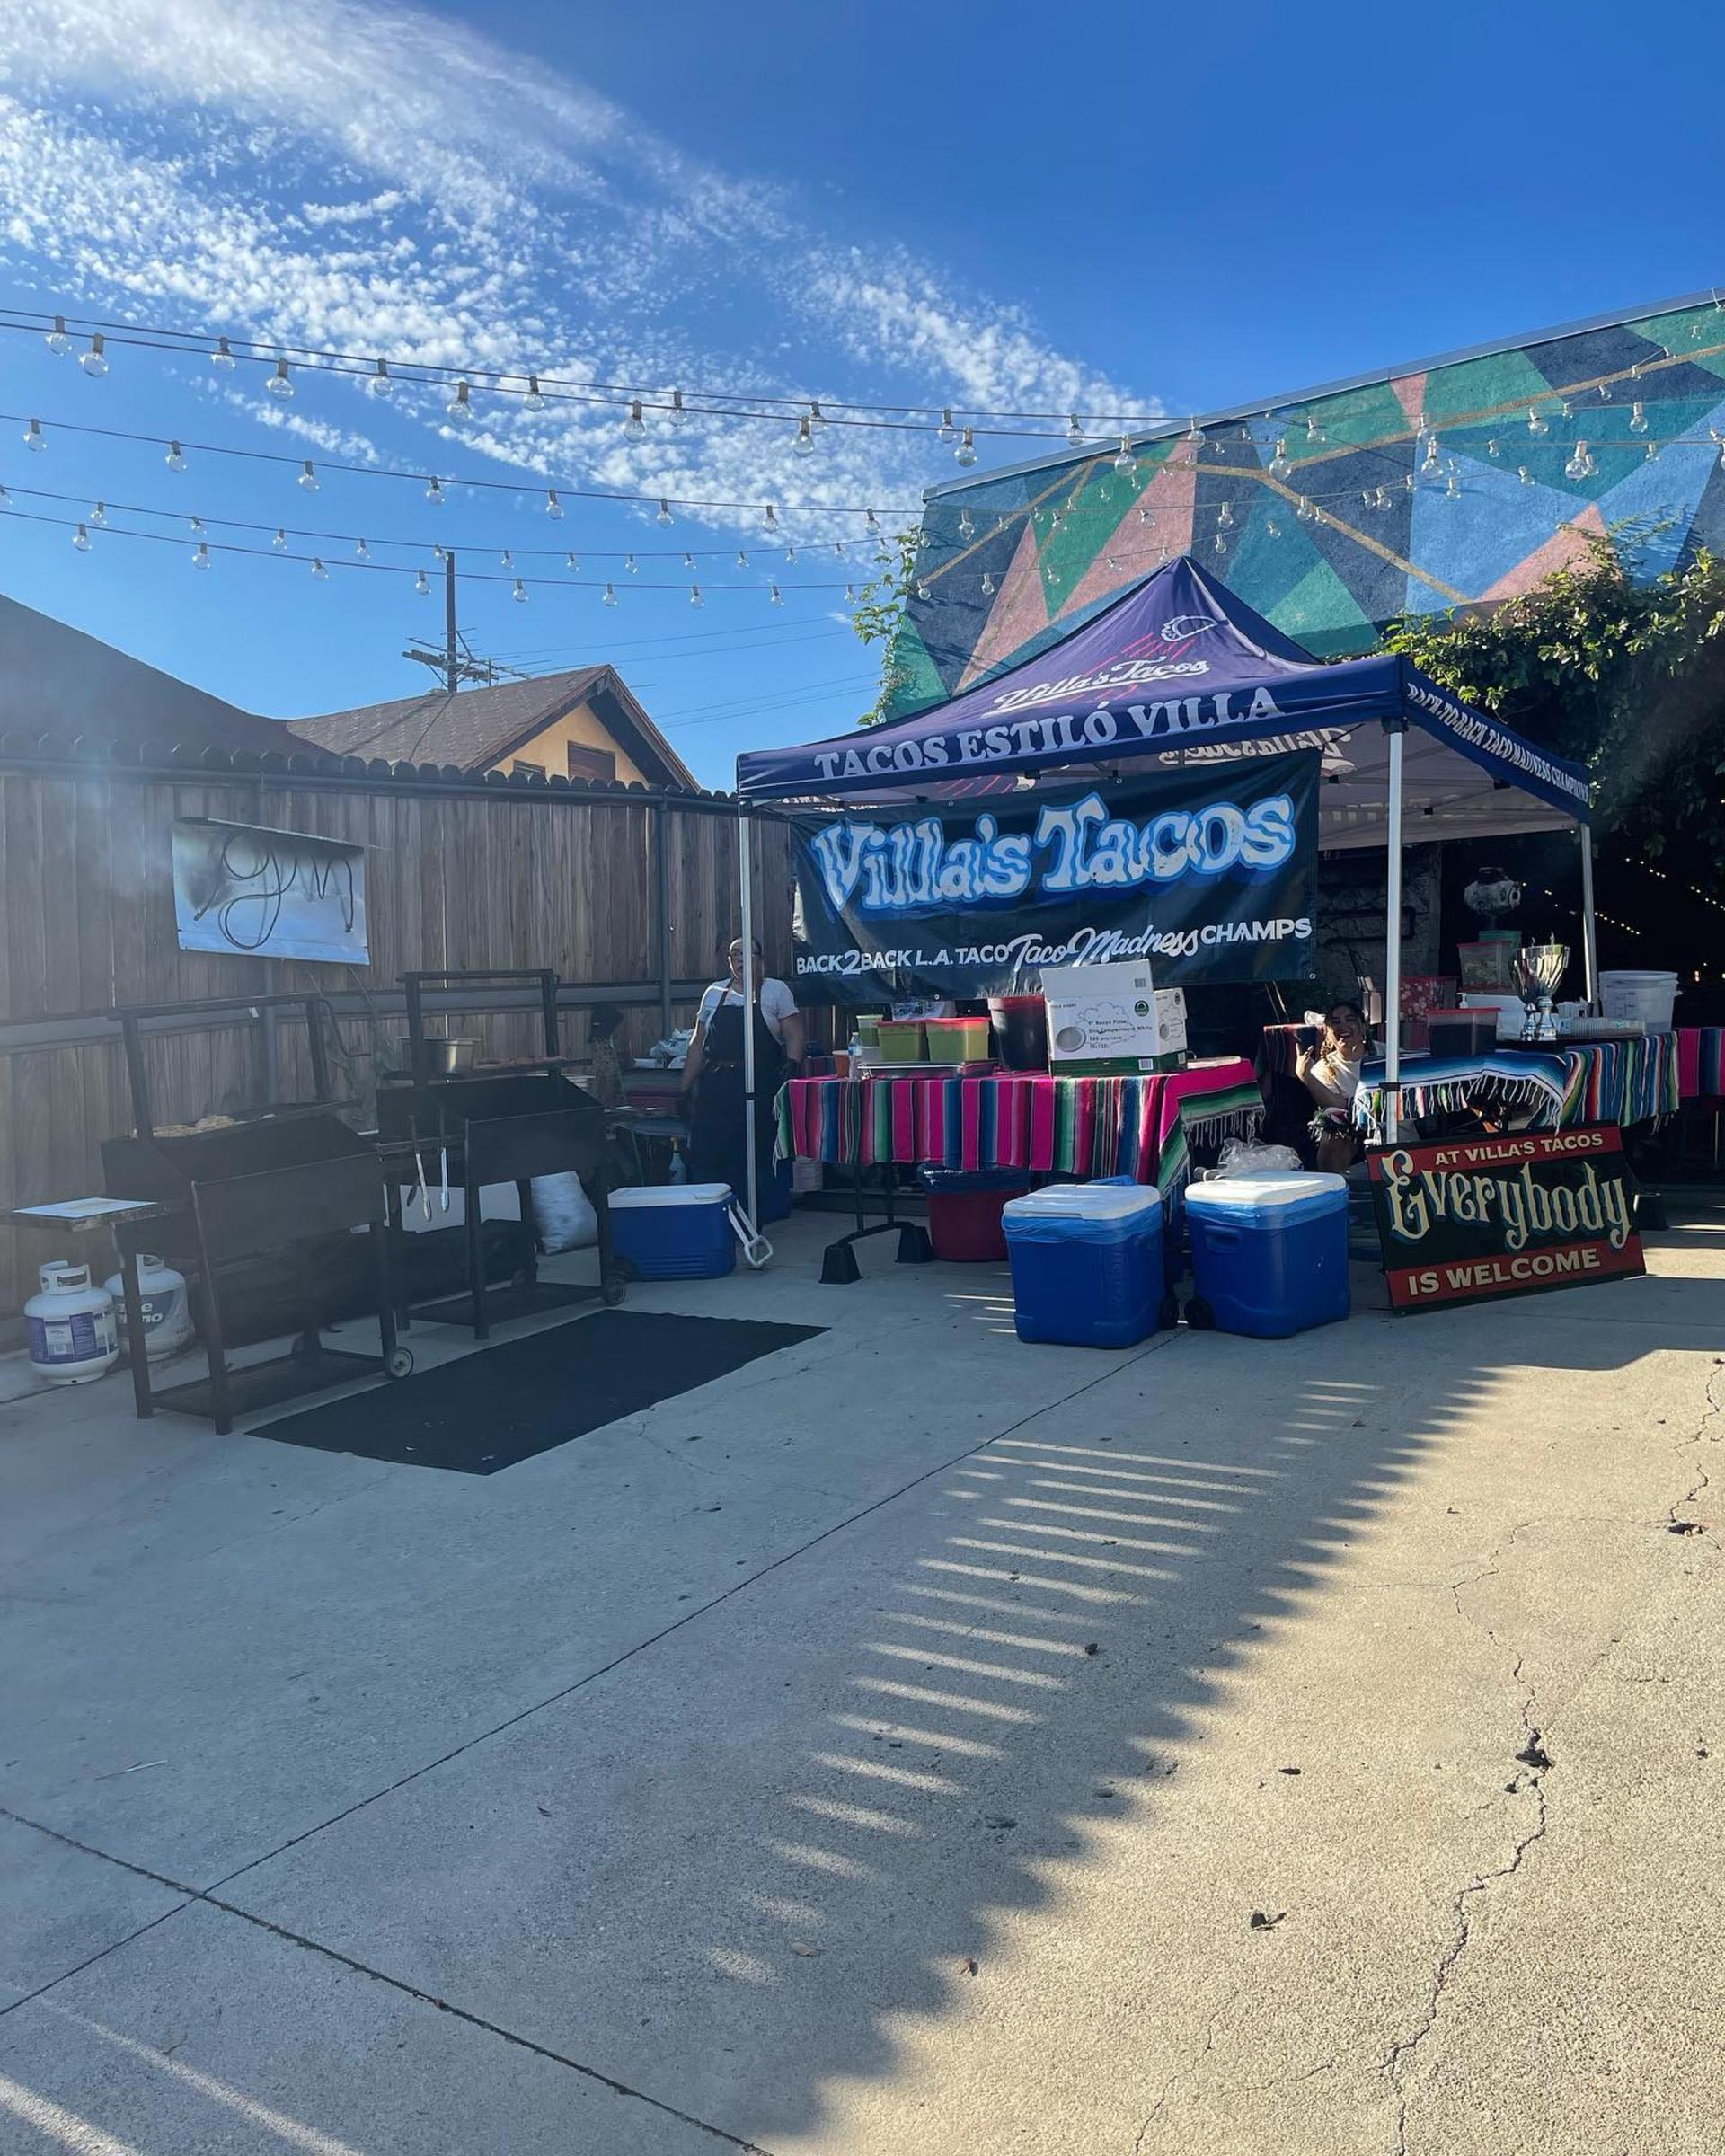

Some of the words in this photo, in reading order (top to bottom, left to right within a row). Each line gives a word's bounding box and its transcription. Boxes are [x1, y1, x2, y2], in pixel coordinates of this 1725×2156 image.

[994, 672, 1110, 708] Villa's
[1111, 656, 1211, 681] Tacos
[814, 735, 951, 780] TACOS
[957, 701, 1118, 764] ESTILÓ
[1128, 686, 1287, 737] VILLA
[1482, 729, 1513, 759] TACO
[1508, 744, 1551, 782] MADNESS
[812, 813, 1033, 910] Villa's
[1034, 792, 1296, 890] Tacos
[915, 948, 954, 967] L.A.
[955, 945, 1009, 965] TACO
[1006, 933, 1068, 973] Taco
[1067, 924, 1199, 968] Madness
[1200, 918, 1313, 944] CHAMPS
[1435, 1150, 1460, 1165] AT
[1464, 1141, 1535, 1162] VILLA'S
[1540, 1133, 1604, 1153] TACOS
[1380, 1150, 1632, 1250] Everybody
[1408, 1272, 1439, 1296] IS
[1445, 1247, 1602, 1290] WELCOME
